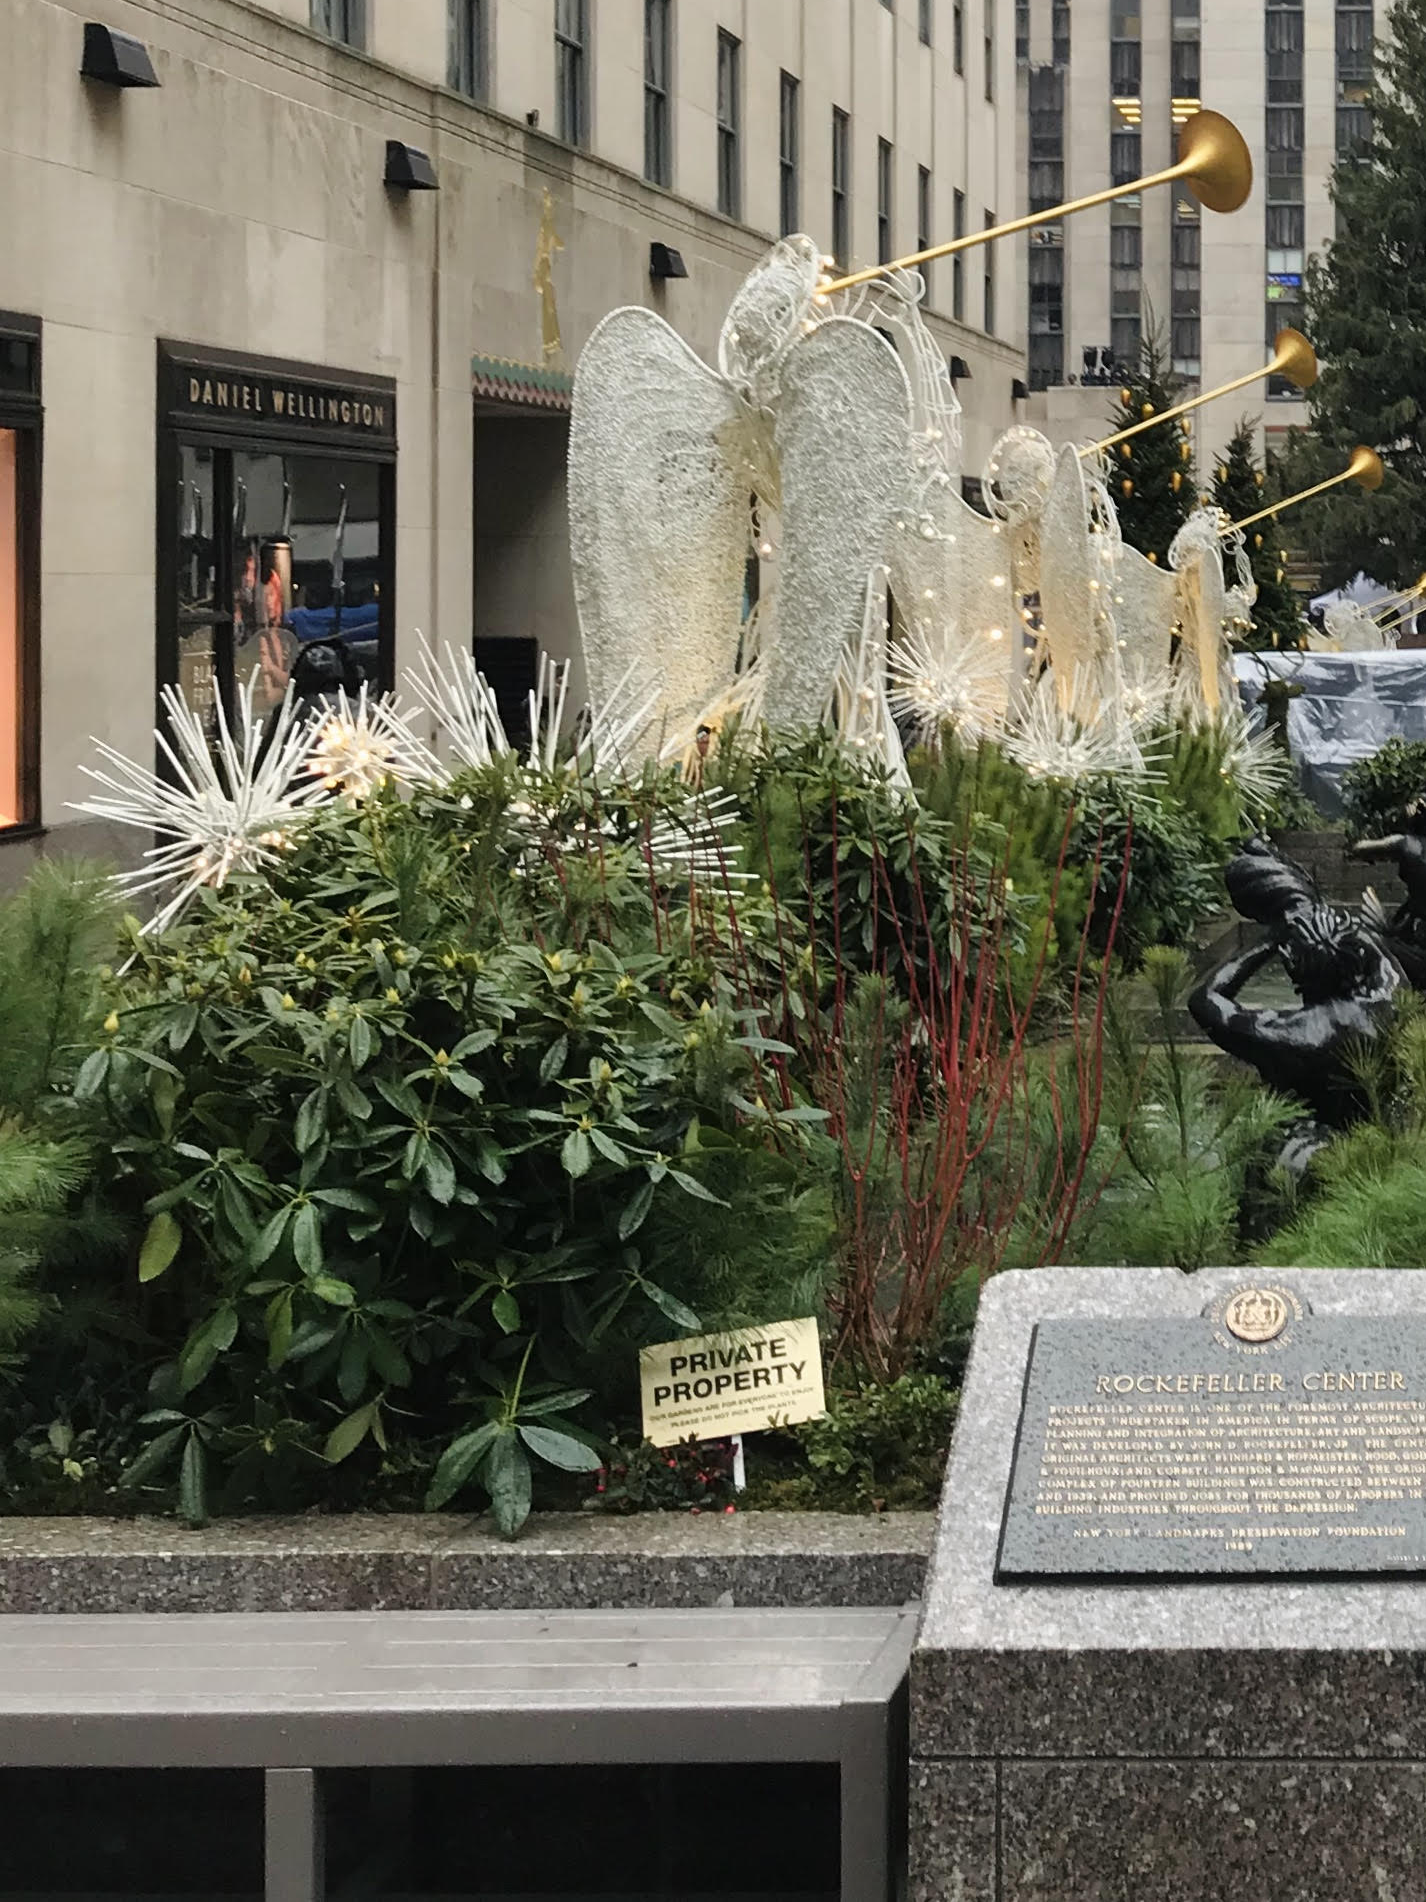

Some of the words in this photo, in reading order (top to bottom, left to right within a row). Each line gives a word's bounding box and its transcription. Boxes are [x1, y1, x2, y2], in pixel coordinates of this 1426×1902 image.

[189, 377, 262, 412] DANIEL
[272, 389, 384, 427] WELLINGTON
[670, 1338, 787, 1376] PRIVATE
[654, 1361, 806, 1406] PROPERTY
[1096, 1372, 1287, 1394] ROCKEFELLER
[1302, 1370, 1407, 1392] CENTER
[1139, 1404, 1184, 1413] CENTER
[1190, 1404, 1201, 1412] IS
[1207, 1403, 1231, 1412] ONE
[1237, 1403, 1252, 1412] OF
[1260, 1403, 1280, 1412] THE
[671, 1418, 698, 1428] PLEASE
[1048, 1417, 1106, 1426] PROJECTS
[1196, 1416, 1209, 1425] IN
[1217, 1415, 1270, 1424] AMERICA
[1276, 1415, 1290, 1424] IN
[1296, 1415, 1336, 1424] TERMS
[1343, 1415, 1360, 1423] OF
[1106, 1429, 1130, 1438] AND
[1134, 1428, 1206, 1438] INTEGRATION
[1210, 1428, 1225, 1437] OF
[1318, 1427, 1339, 1436] ART
[1342, 1427, 1366, 1436] AND
[1044, 1442, 1056, 1451] IT
[1062, 1441, 1087, 1451] WAS
[1093, 1441, 1163, 1450] DEVELOPED
[1170, 1441, 1183, 1450] BY
[1191, 1440, 1222, 1449] JOHN
[1365, 1439, 1387, 1448] THE
[1041, 1454, 1097, 1464] ORIGINAL
[1100, 1453, 1171, 1463] ARCHITECTS
[1126, 1466, 1152, 1476] AND
[1368, 1464, 1390, 1473] THE
[1038, 1479, 1096, 1489] COMPLEX
[1100, 1479, 1116, 1488] OF
[1121, 1478, 1180, 1488] FOURTEEN
[1186, 1478, 1245, 1488] BUILDINGS
[1249, 1478, 1273, 1487] WAS
[1367, 1476, 1422, 1486] BETWEEN
[1036, 1492, 1063, 1502] AND
[1100, 1492, 1126, 1501] AND
[1130, 1491, 1188, 1501] PROVIDED
[1192, 1491, 1221, 1500] JOBS
[1226, 1491, 1249, 1500] FOR
[1255, 1490, 1321, 1499] THOUSANDS
[1326, 1490, 1340, 1499] OF
[1409, 1489, 1421, 1498] IN
[1035, 1504, 1092, 1514] BUILDING
[1098, 1504, 1169, 1514] INDUSTRIES
[1175, 1503, 1250, 1513] THROUGHOUT
[1257, 1503, 1280, 1512] THE
[1073, 1529, 1101, 1538] NEW
[1231, 1528, 1319, 1537] PRESERVATION
[1327, 1527, 1406, 1537] FOUNDATION
